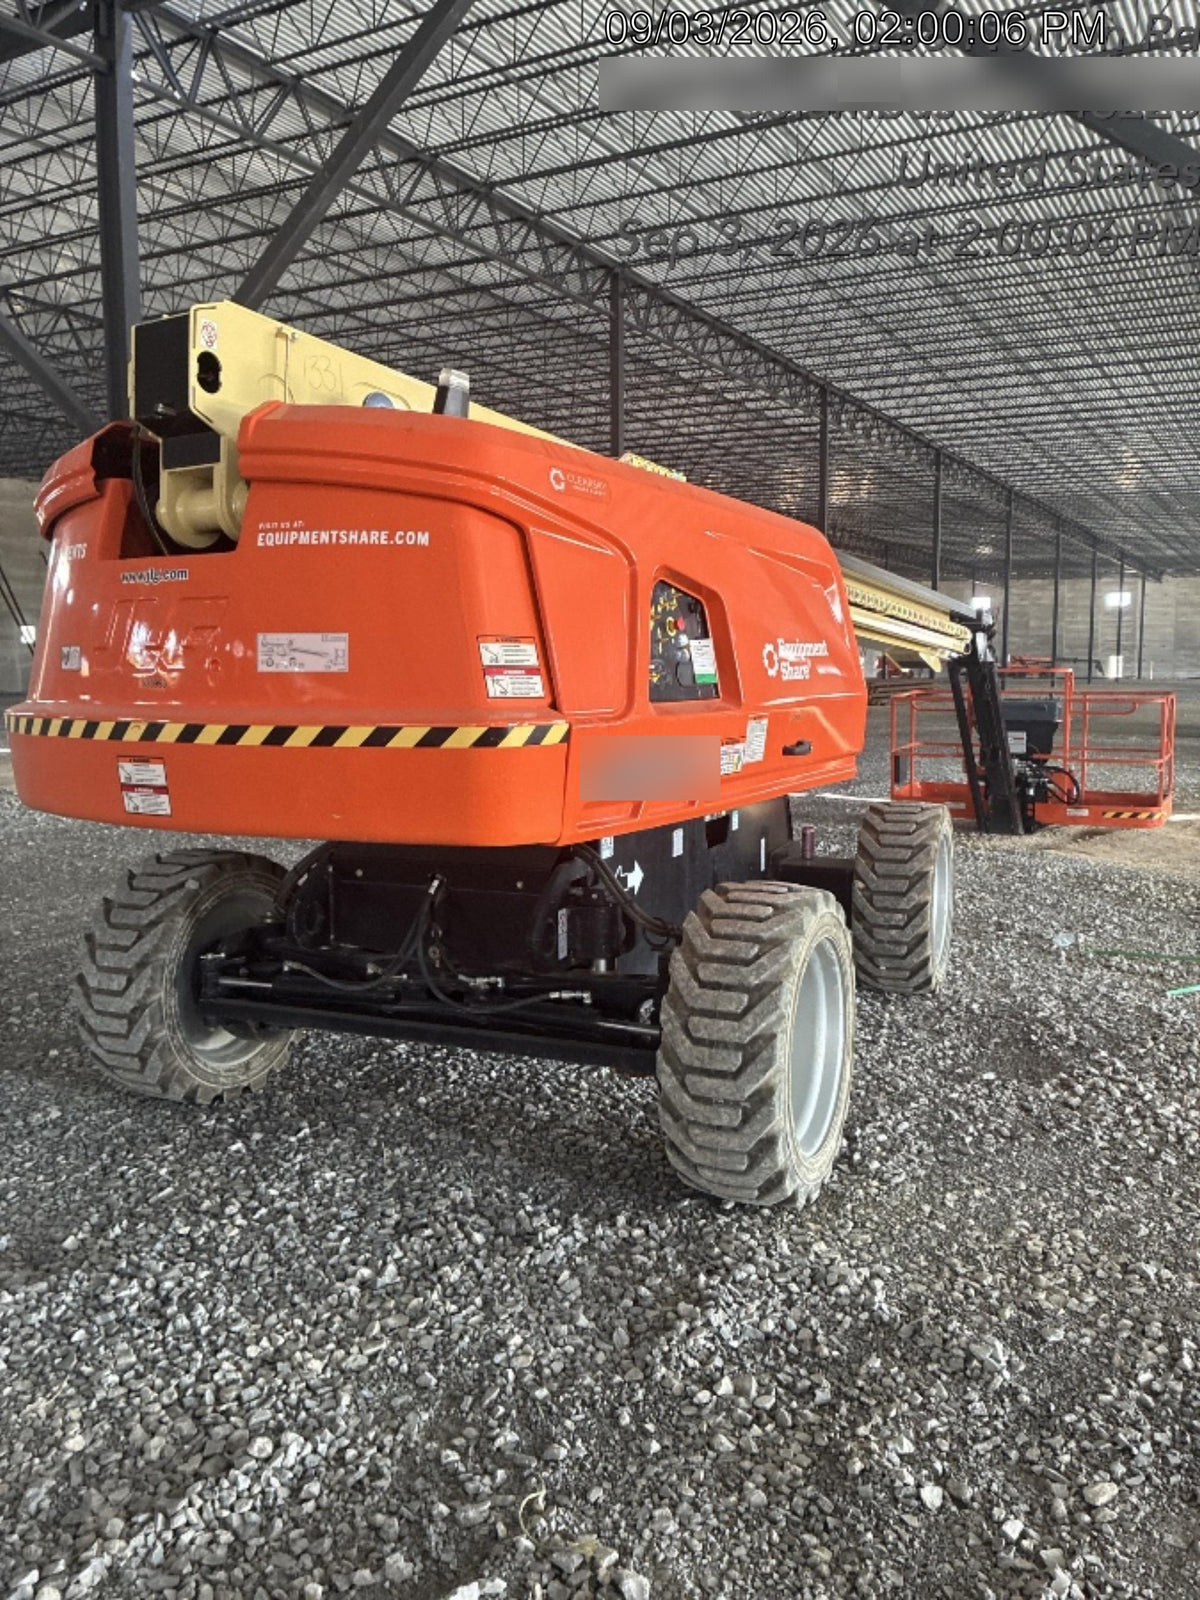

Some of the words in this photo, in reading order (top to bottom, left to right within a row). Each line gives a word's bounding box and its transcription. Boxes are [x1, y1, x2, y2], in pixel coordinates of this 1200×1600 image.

[257, 530, 430, 547] EQUIPMENTSHARE.COM
[120, 567, 189, 585] www.jlg.com
[777, 638, 829, 662] Equipment
[780, 660, 811, 682] Share
